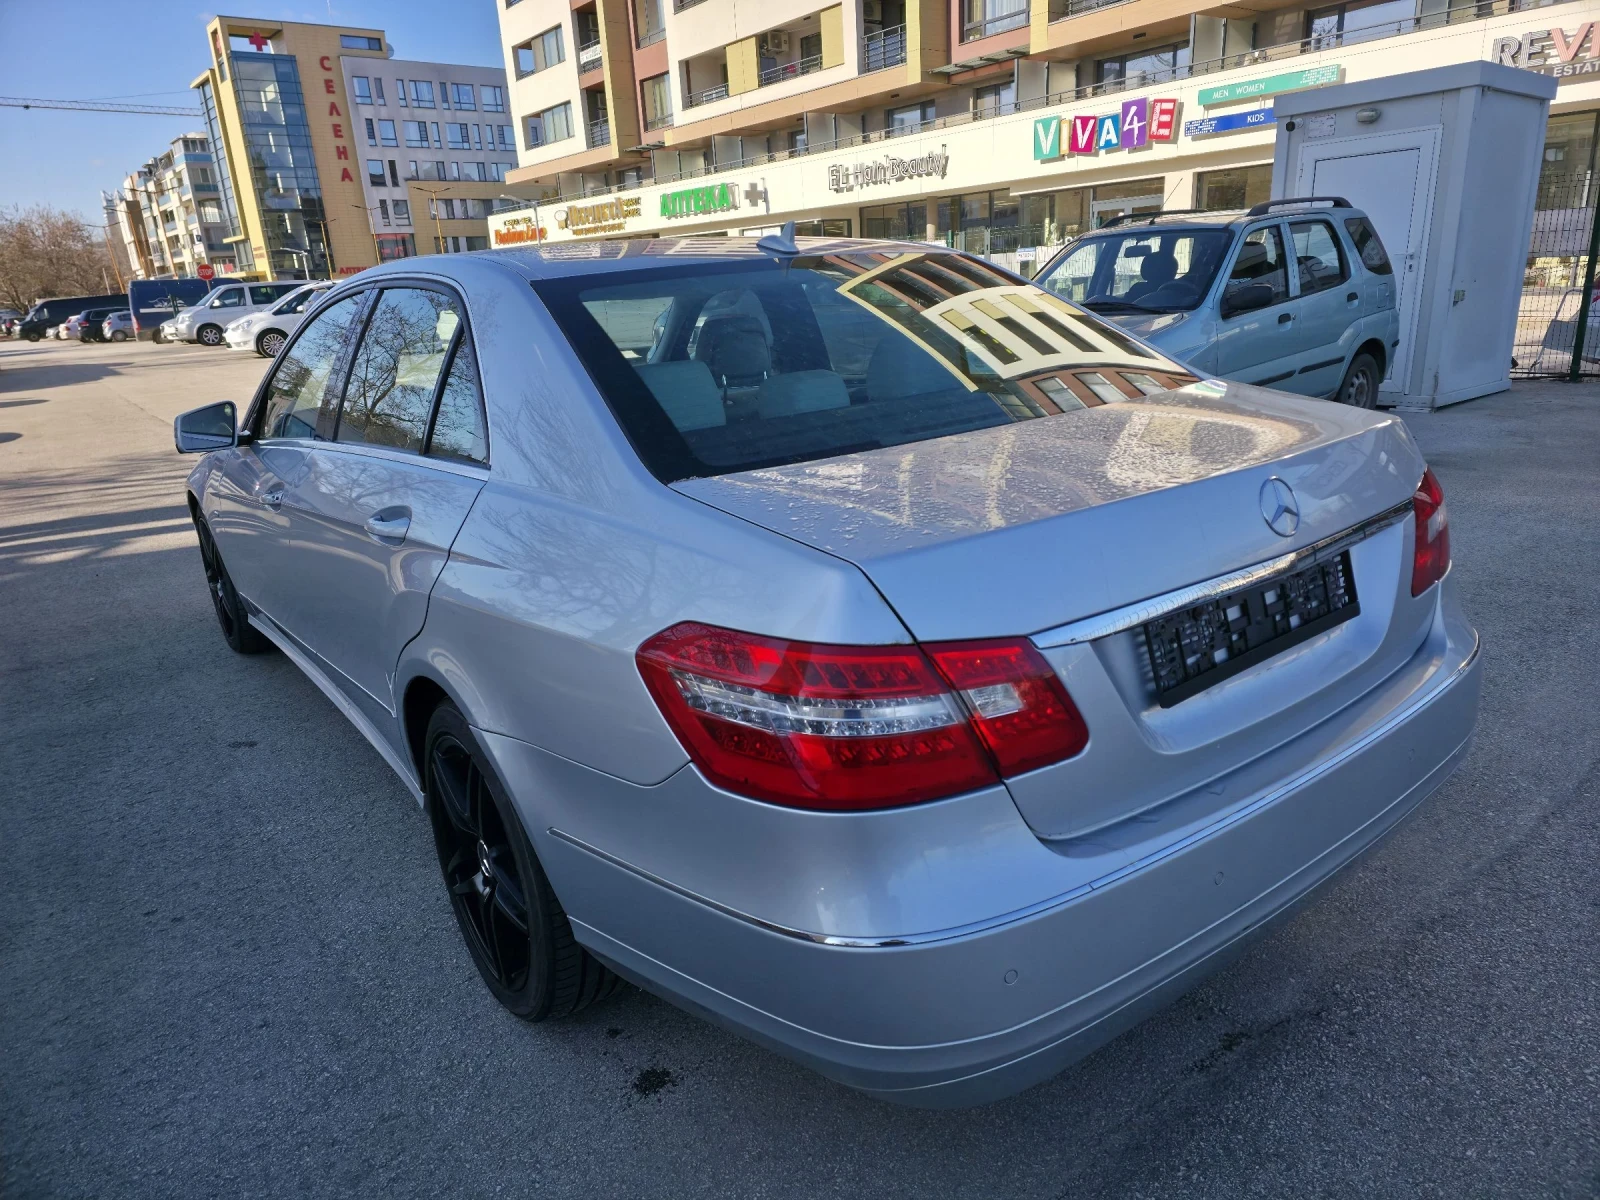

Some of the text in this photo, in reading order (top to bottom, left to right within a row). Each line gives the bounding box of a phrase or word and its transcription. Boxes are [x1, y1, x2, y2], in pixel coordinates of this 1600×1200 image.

[1212, 82, 1265, 99] MEN WOMEN
[319, 56, 354, 182] СЕЛЕНА
[1035, 102, 1175, 156] VIVA4E
[1247, 112, 1265, 123] KIDS
[888, 152, 943, 179] Beauty
[660, 183, 732, 217] АПТЕКА
[199, 268, 213, 276] STOP
